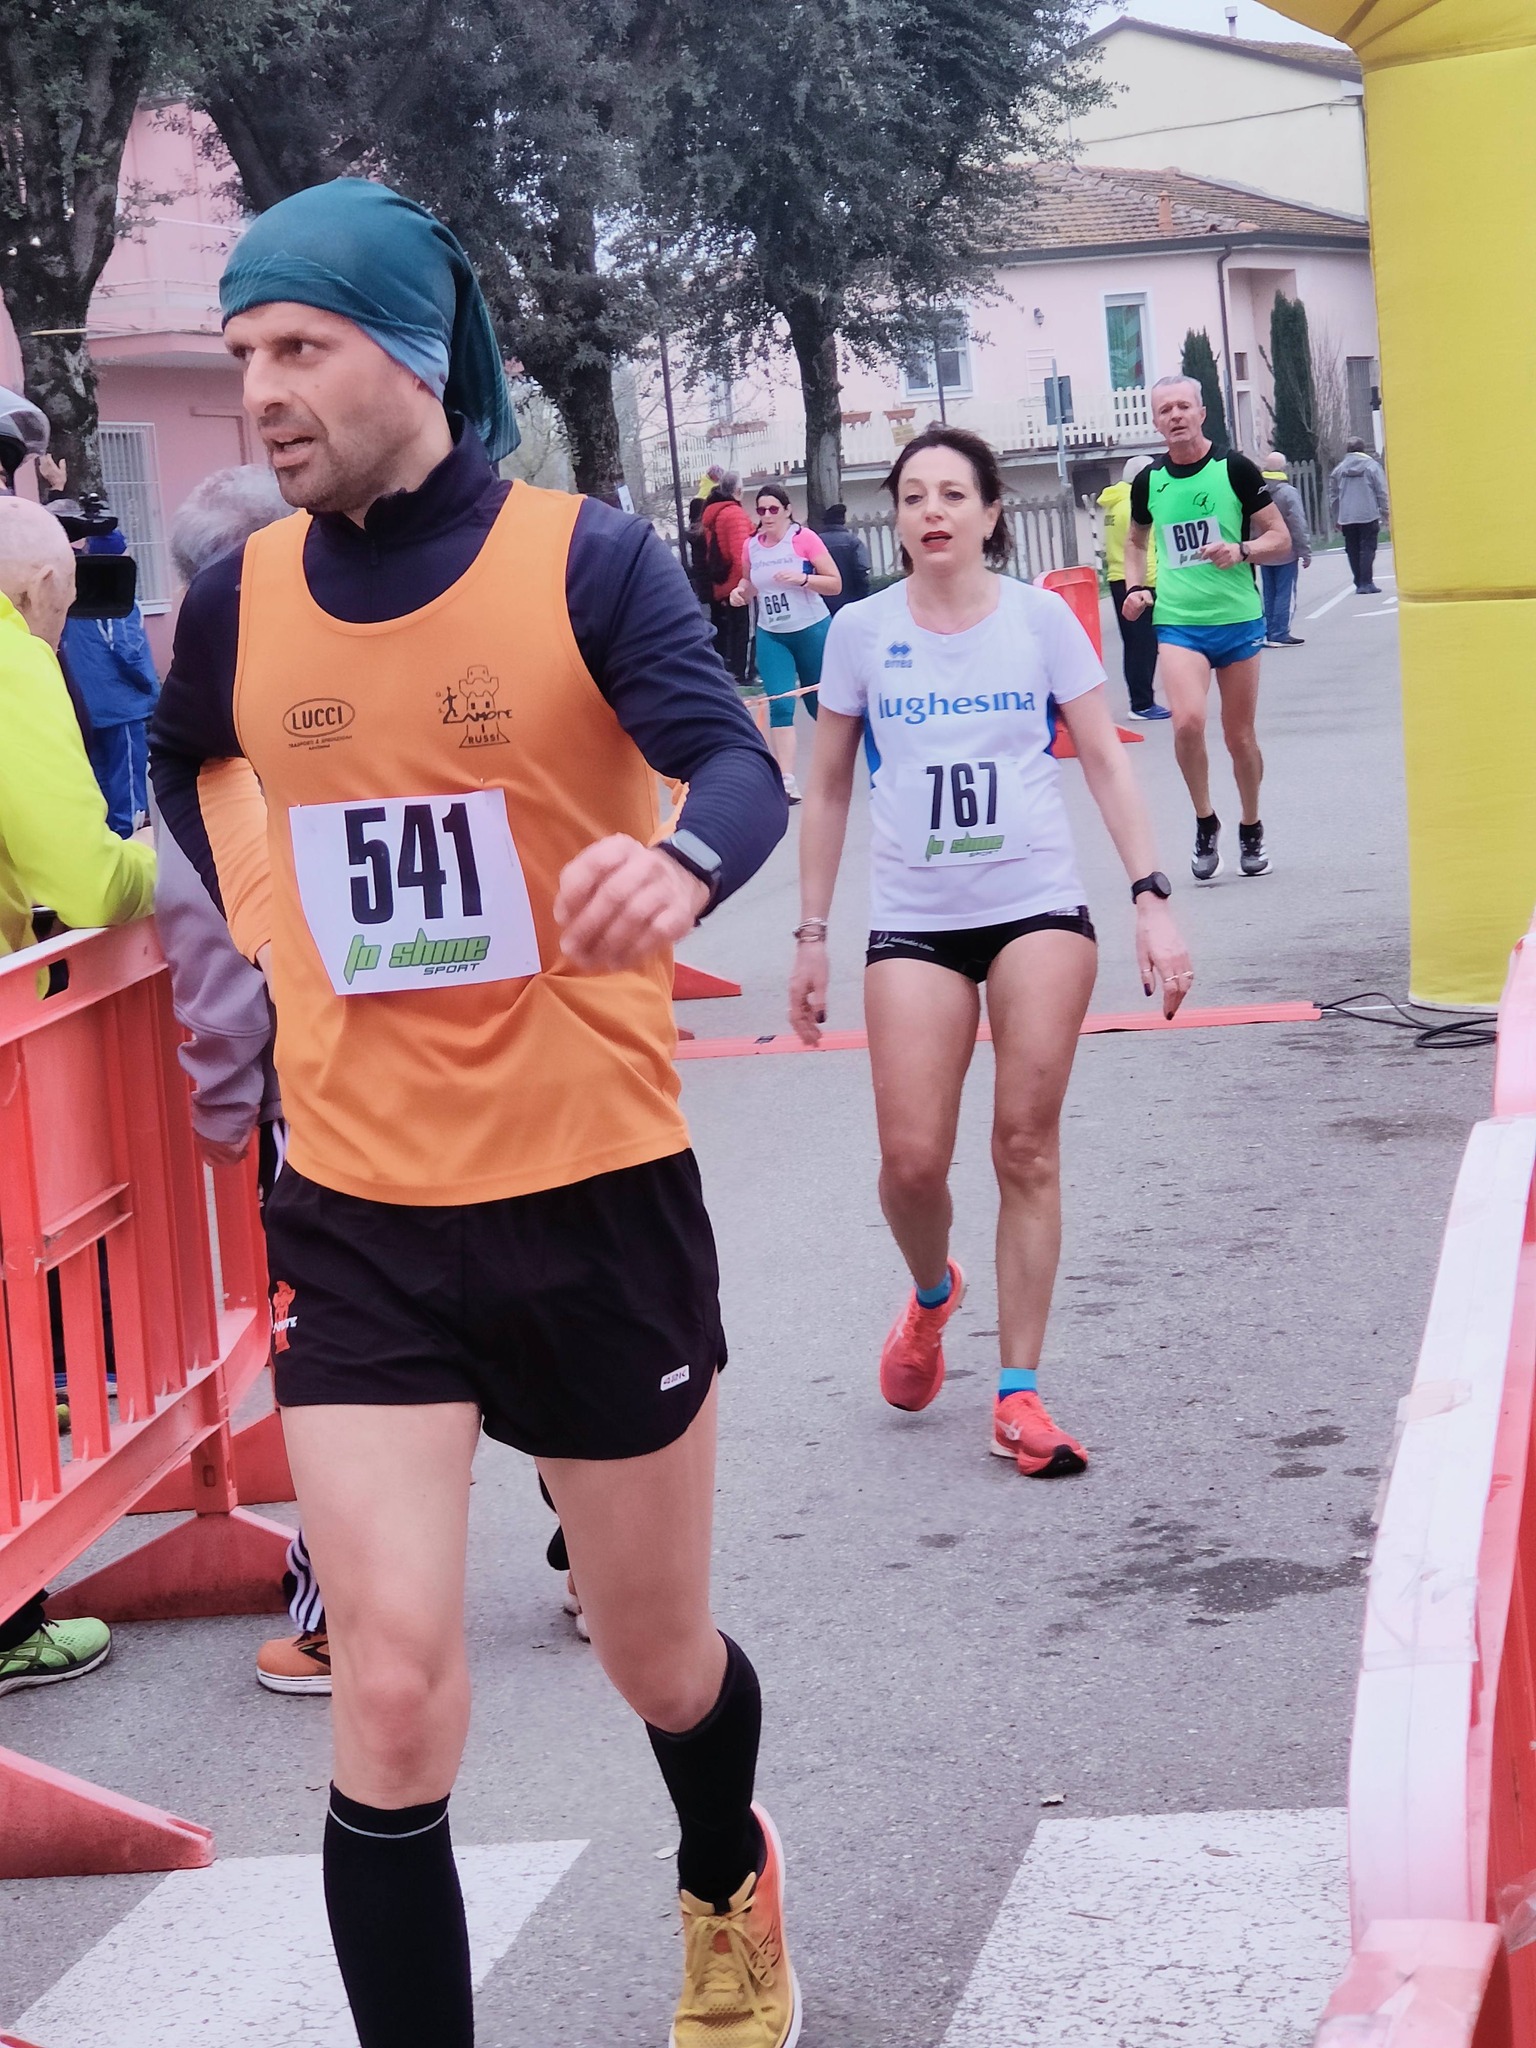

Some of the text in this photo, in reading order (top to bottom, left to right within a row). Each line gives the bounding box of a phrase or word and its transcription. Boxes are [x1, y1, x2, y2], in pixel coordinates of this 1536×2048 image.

[1173, 520, 1210, 552] 602
[764, 592, 790, 615] 664
[292, 706, 343, 730] LUCCI
[879, 691, 1036, 724] lughesina
[468, 734, 500, 744] RUSSI
[926, 761, 998, 829] 767
[344, 802, 483, 925] 541
[389, 927, 491, 968] shine
[423, 962, 480, 976] SPORT
